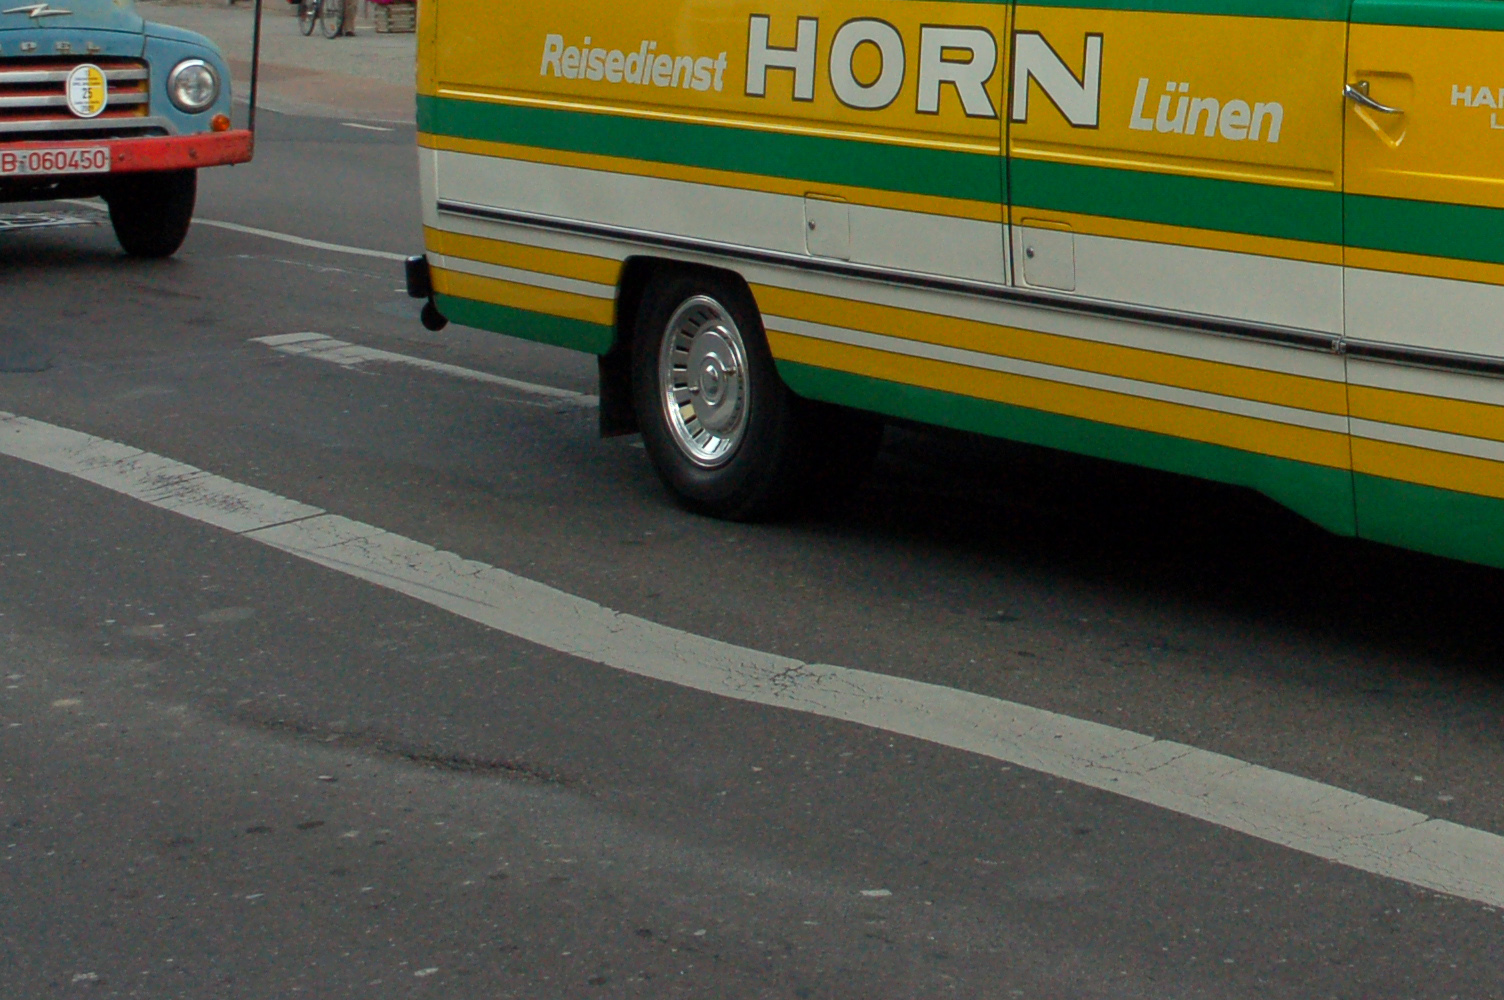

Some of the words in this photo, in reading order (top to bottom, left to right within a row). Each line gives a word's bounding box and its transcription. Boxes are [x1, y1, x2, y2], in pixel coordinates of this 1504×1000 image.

[0, 40, 101, 54] PEL
[539, 33, 728, 92] Reisedienst
[743, 12, 1104, 131] HORN
[1128, 77, 1285, 144] Lünen
